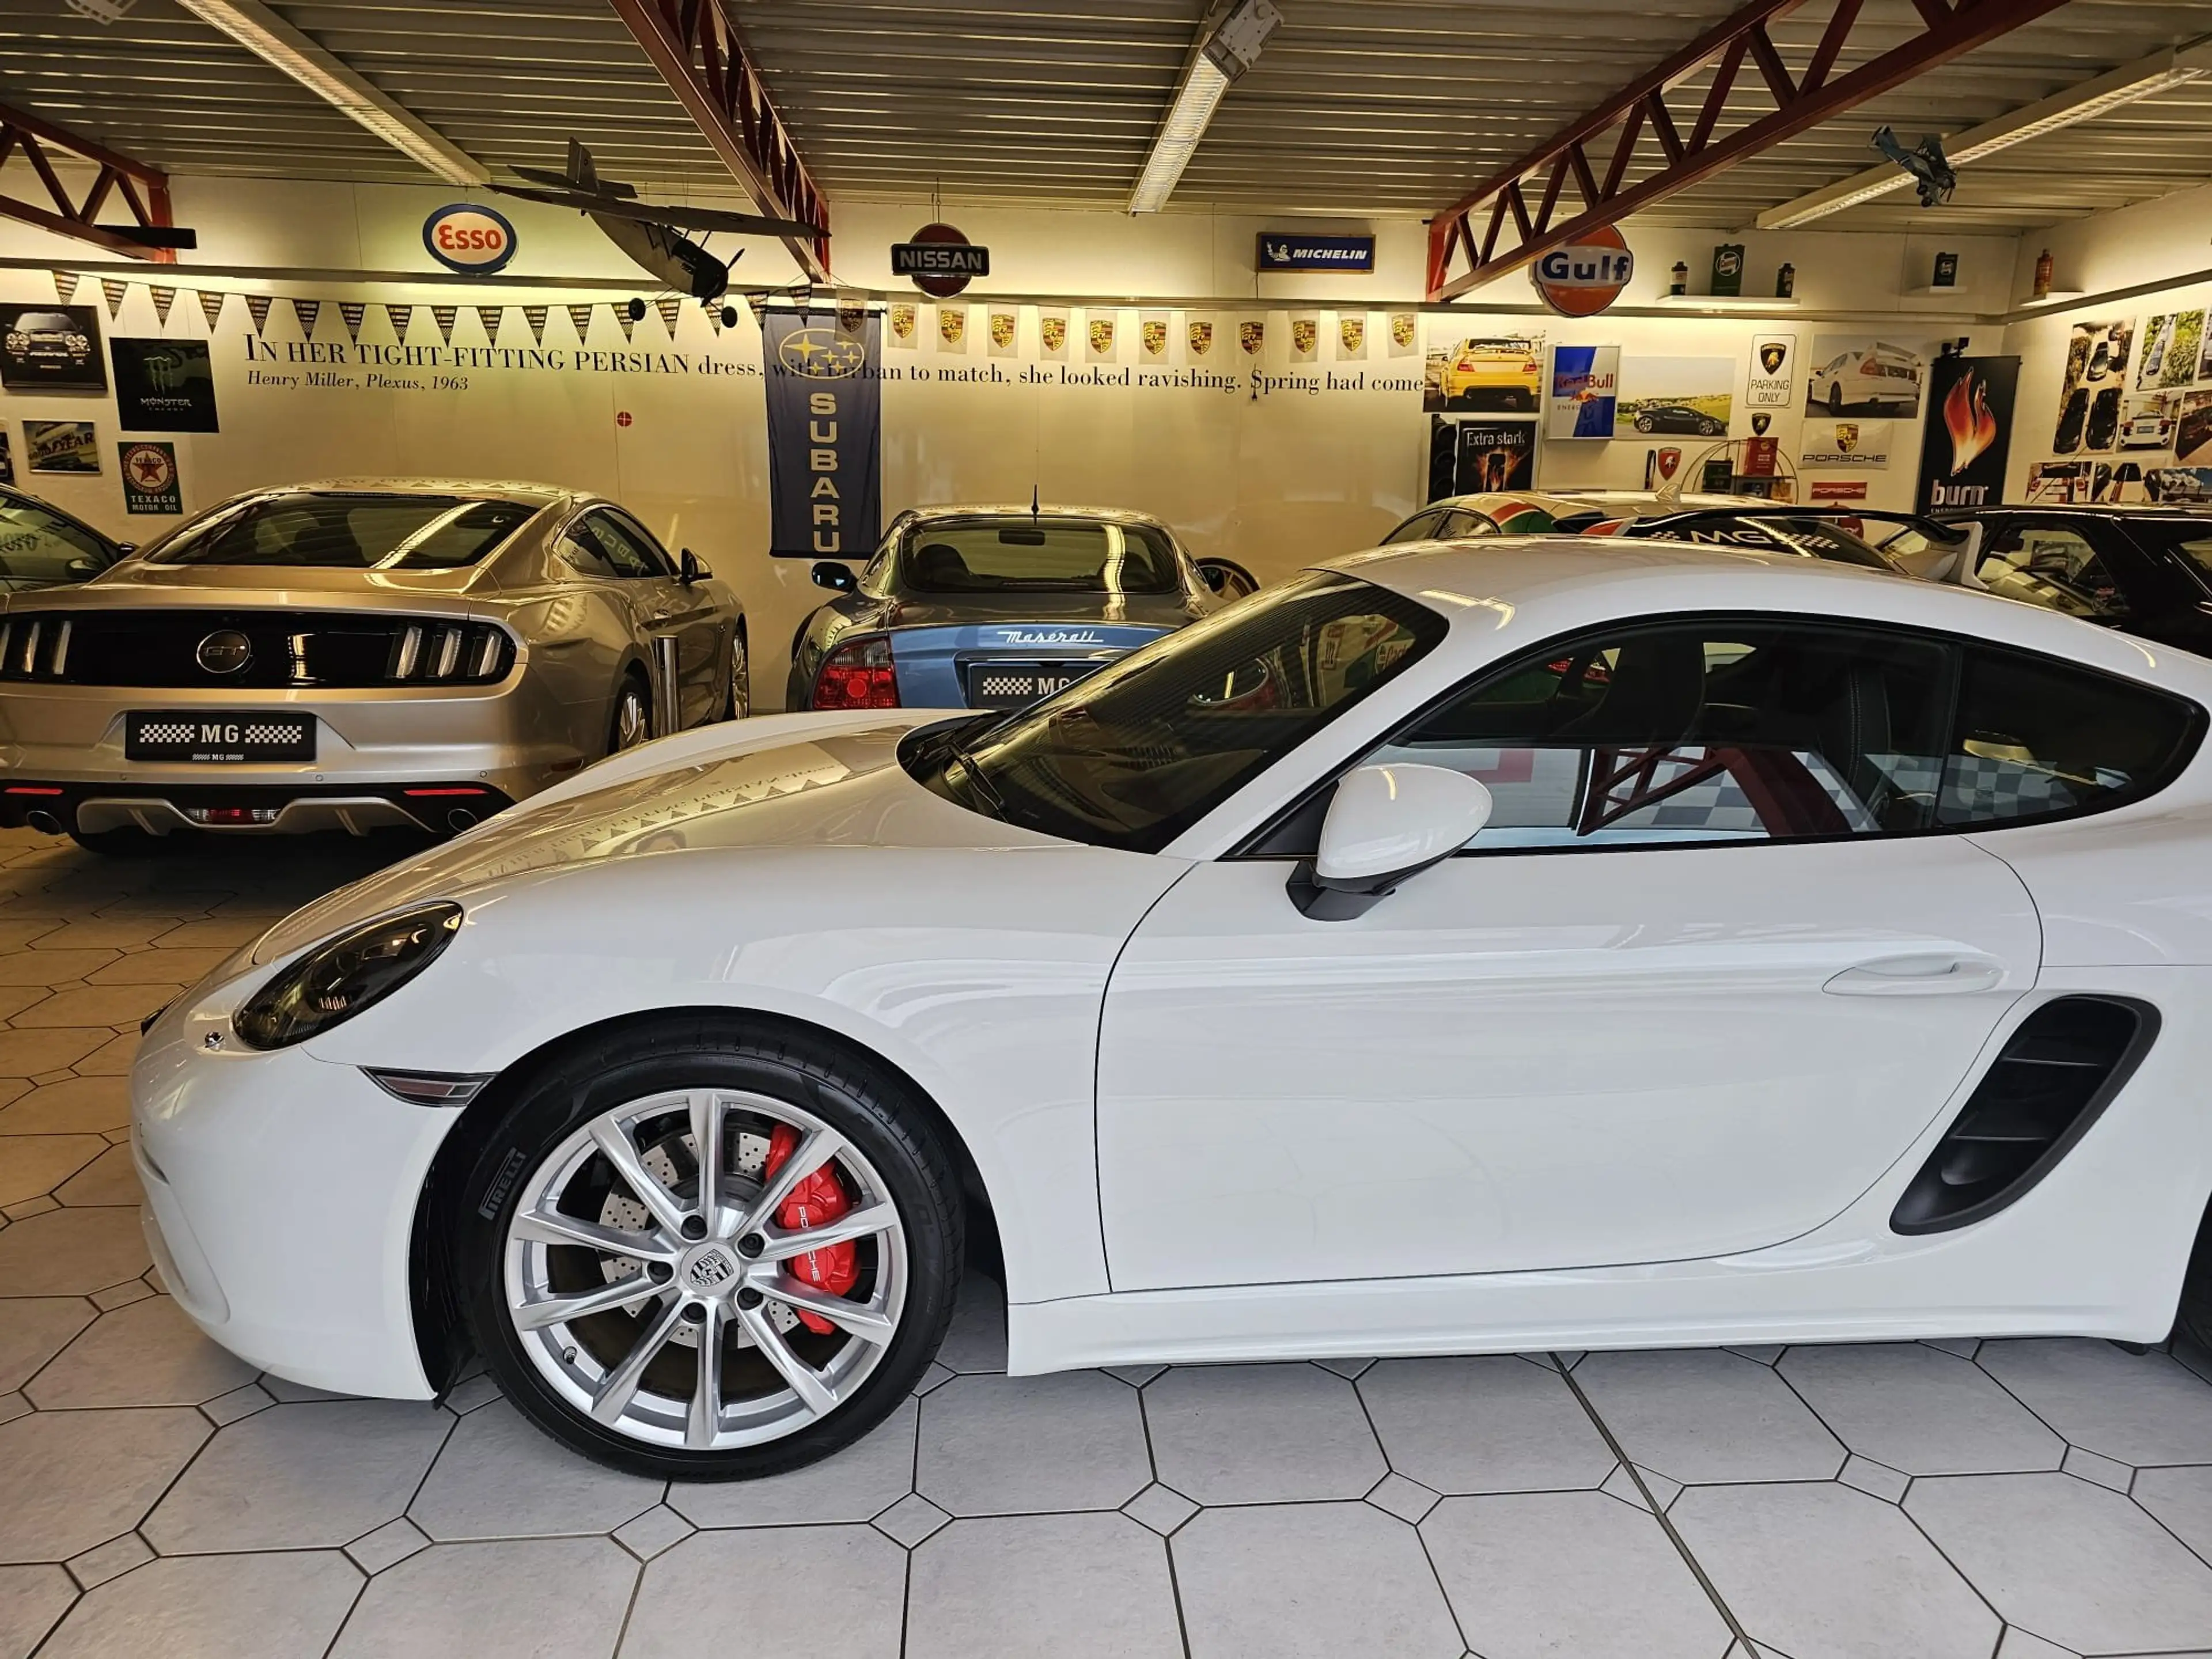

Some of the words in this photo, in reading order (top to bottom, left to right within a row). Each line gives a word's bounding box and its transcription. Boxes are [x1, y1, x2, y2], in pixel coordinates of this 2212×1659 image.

[900, 251, 983, 270] NISSAN
[1293, 249, 1368, 260] MICHELIN
[1541, 251, 1630, 281] Gulf
[286, 341, 347, 364] HER
[354, 344, 566, 370] TIGHT-FITTING
[574, 351, 690, 374] PERSIAN
[698, 355, 765, 380] dress,
[910, 365, 930, 381] to
[938, 363, 1012, 387] match,
[1019, 365, 1054, 384] she
[1059, 366, 1130, 387] looked
[1138, 368, 1242, 395] ravishing.
[1251, 369, 1320, 396] Spring
[1327, 372, 1364, 391] had
[1371, 377, 1424, 391] come
[248, 370, 300, 391] Henry
[305, 372, 360, 390] Miller,
[367, 373, 425, 392] Plexus,
[432, 376, 469, 391] 1963
[1588, 373, 1613, 388] Bull
[1751, 379, 1790, 390] PARKING
[140, 397, 193, 407] MONSTER
[1758, 392, 1781, 403] ONLY
[1467, 431, 1494, 446] Extra
[1497, 430, 1525, 445] stark
[1802, 454, 1887, 462] PORSCHE
[809, 392, 842, 553] SUBARU
[130, 495, 176, 503] TEXACO
[1930, 479, 1984, 505] burn
[1690, 531, 1773, 545] MG
[997, 630, 1104, 644] Maserati
[200, 724, 240, 744] MG
[211, 753, 225, 761] MG
[478, 1147, 527, 1221] PIRELLI
[798, 1206, 821, 1282] POCHE
